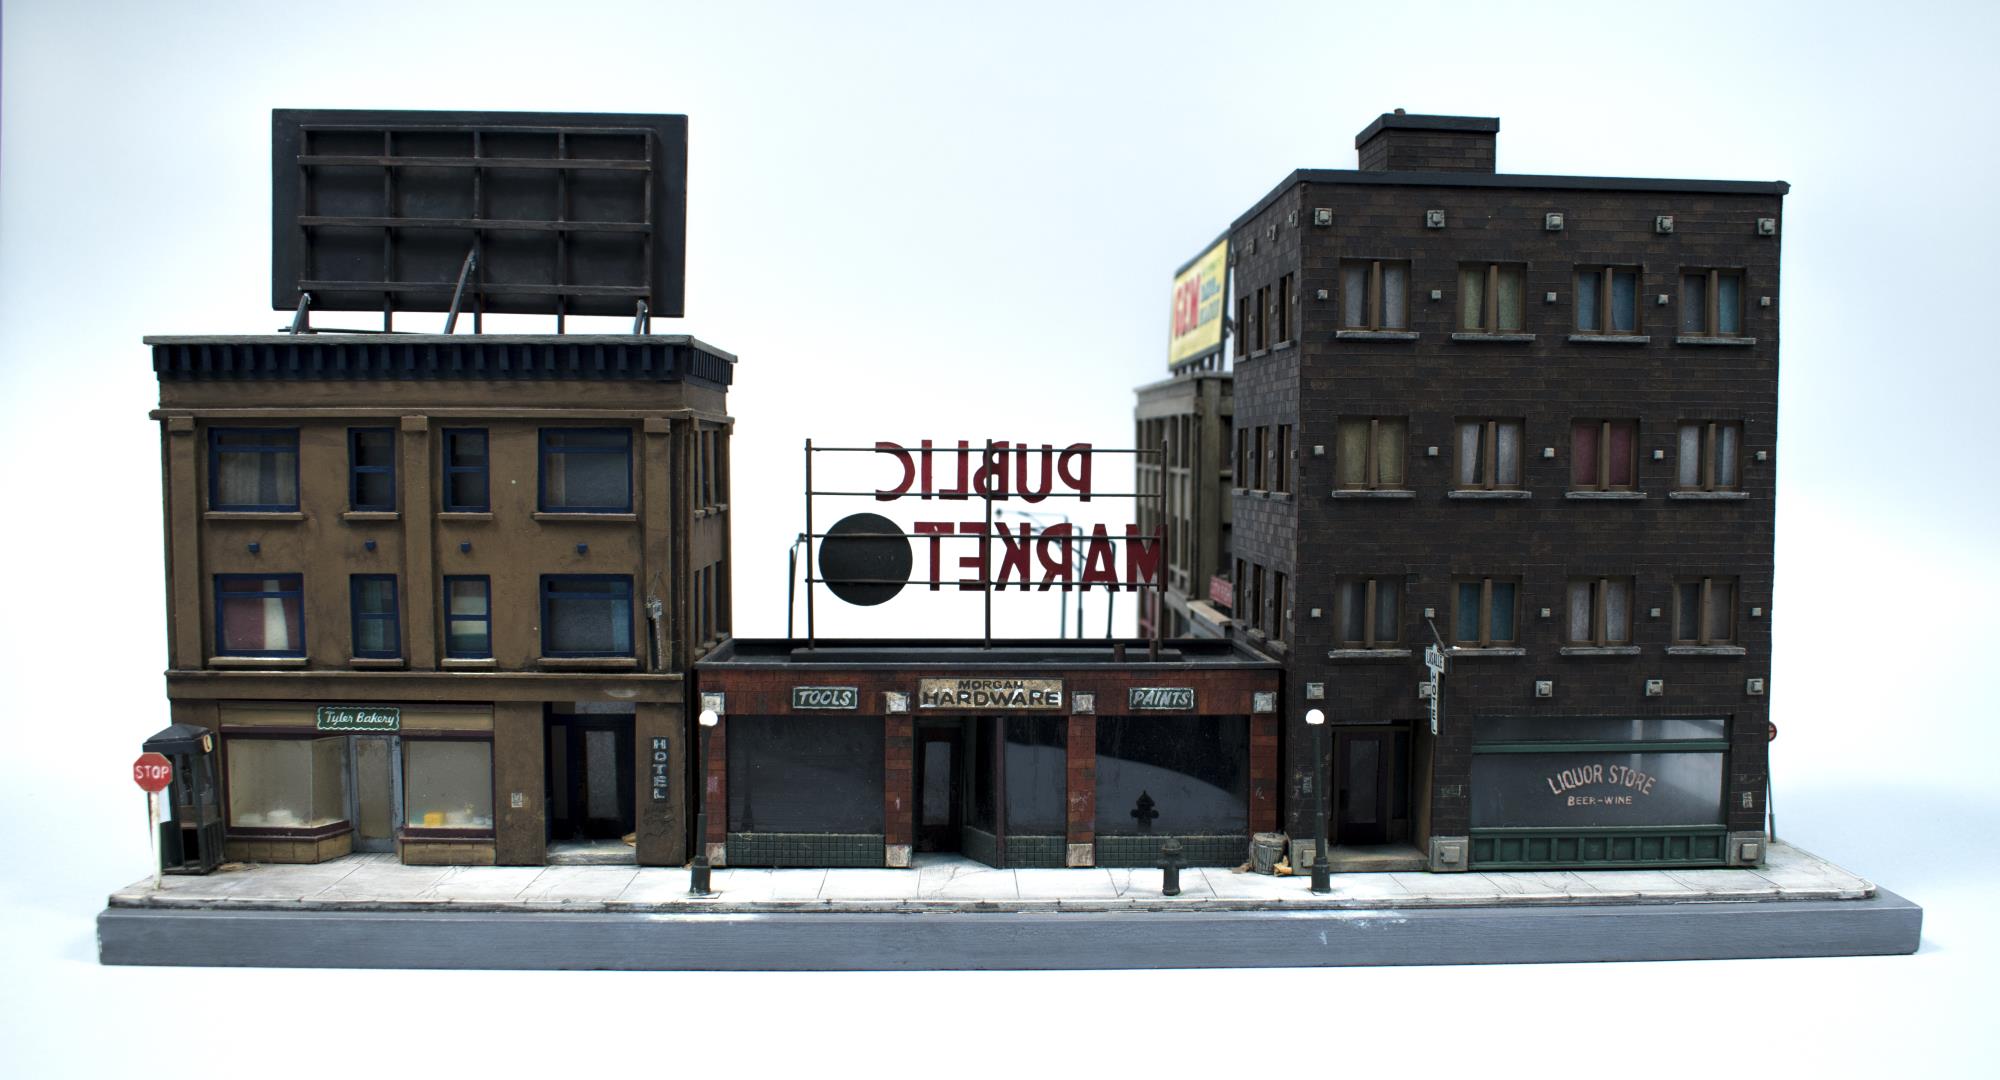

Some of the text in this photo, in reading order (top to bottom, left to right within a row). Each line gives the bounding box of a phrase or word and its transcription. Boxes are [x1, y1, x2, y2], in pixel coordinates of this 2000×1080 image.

[958, 679, 1024, 690] MORGAN
[799, 690, 851, 706] TOOLS
[922, 689, 1060, 706] HARDWARE
[1133, 690, 1191, 706] PAINTS
[325, 711, 395, 726] Tyler Bakery
[135, 765, 169, 779] STOP
[653, 738, 667, 799] HOTEL
[1547, 764, 1657, 795] LIQUOR STORE
